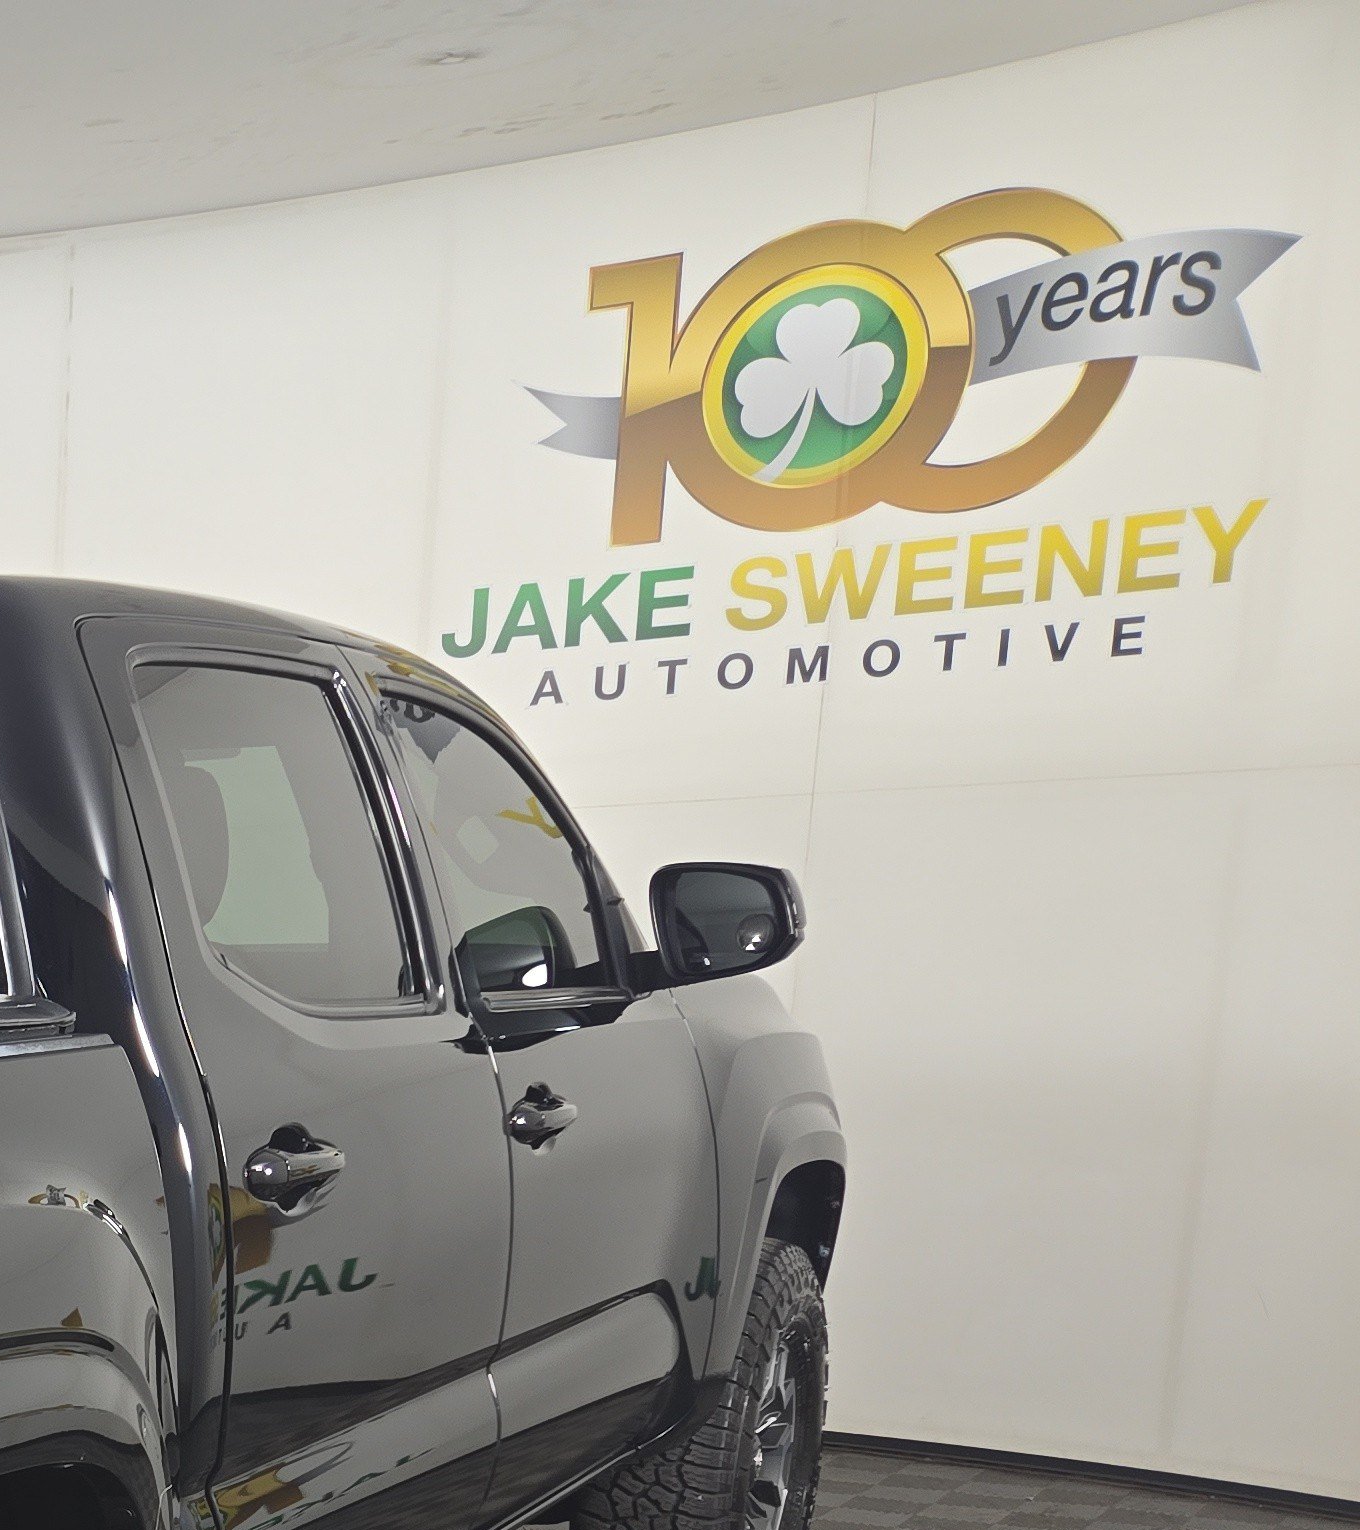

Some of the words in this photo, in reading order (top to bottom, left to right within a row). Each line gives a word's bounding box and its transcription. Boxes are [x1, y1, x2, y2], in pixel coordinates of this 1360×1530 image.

[990, 249, 1222, 367] years
[440, 564, 696, 659] JAKE
[724, 497, 1270, 632] SWEENEY
[530, 615, 1147, 707] AUTOMOTIVE
